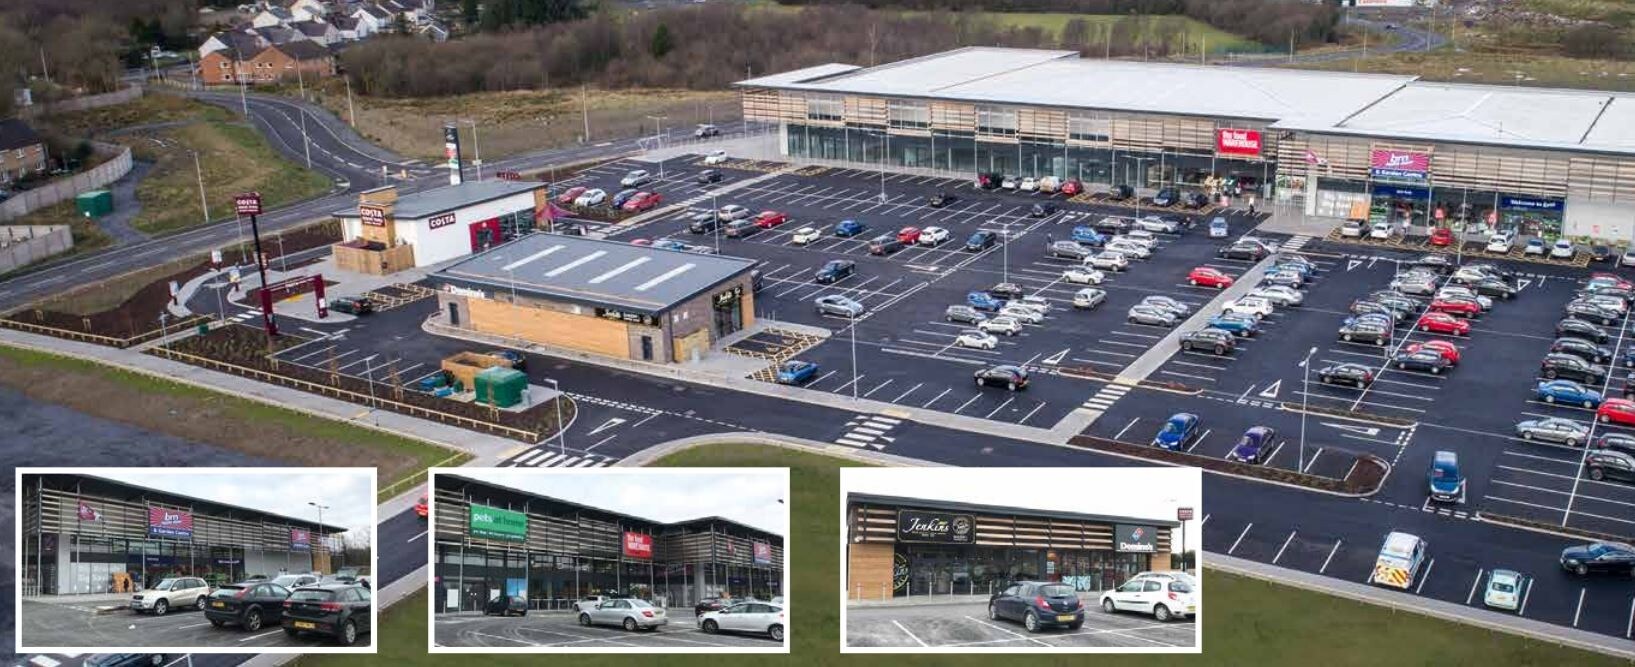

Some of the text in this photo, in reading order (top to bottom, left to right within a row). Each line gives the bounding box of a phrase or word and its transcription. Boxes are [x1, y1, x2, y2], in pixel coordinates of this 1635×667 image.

[361, 208, 382, 217] COSTA
[430, 216, 455, 228] COSTA
[473, 513, 493, 523] pets
[902, 517, 950, 533] Jenkins
[1120, 542, 1153, 551] Domino's
